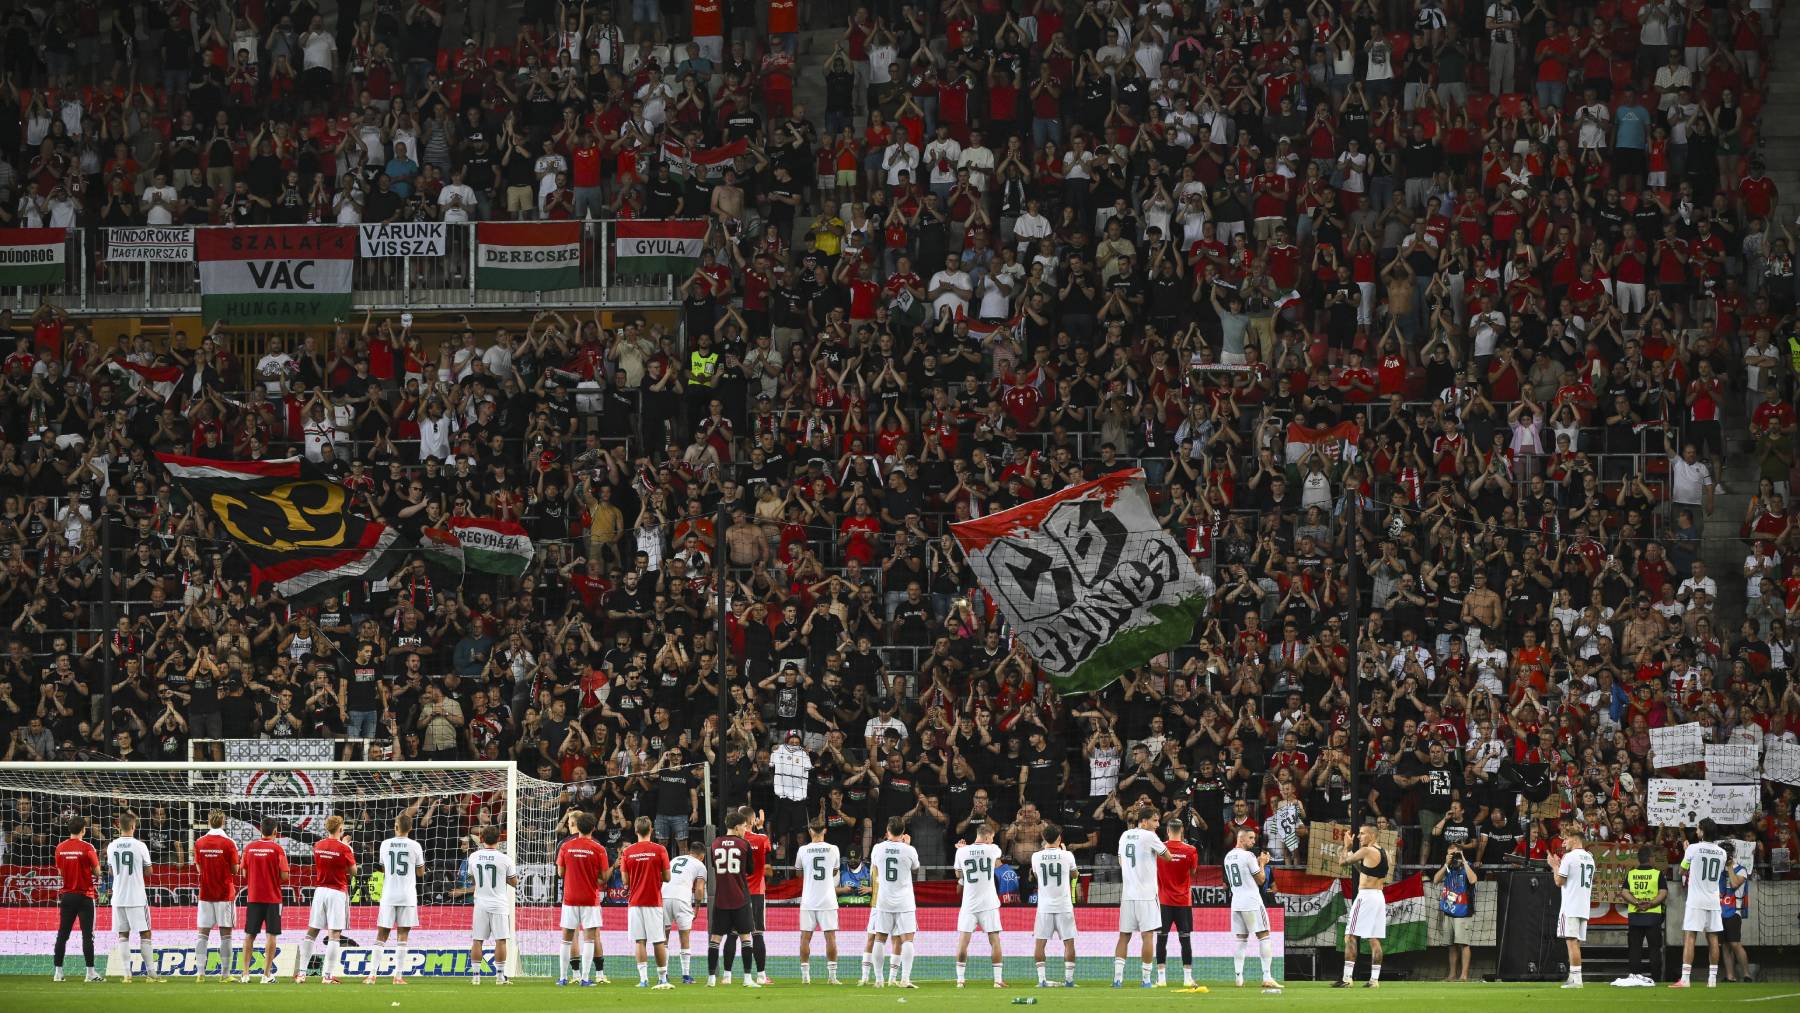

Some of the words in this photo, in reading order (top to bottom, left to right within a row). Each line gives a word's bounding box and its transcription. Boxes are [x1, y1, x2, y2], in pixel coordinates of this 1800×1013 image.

[368, 240, 438, 256] VISSZA
[486, 248, 579, 263] DERECSKE
[636, 240, 686, 254] GYULA
[246, 260, 315, 290] VÁC
[226, 301, 320, 317] HUNGARY
[113, 850, 134, 876] 19
[388, 850, 409, 876] 15
[672, 858, 689, 874] 2
[714, 848, 741, 874] 26
[1125, 843, 1137, 868] 9
[476, 863, 497, 889] 17
[813, 856, 826, 881] 5
[885, 857, 898, 882] 6
[964, 857, 992, 884] 24
[1040, 862, 1062, 887] 14
[1225, 863, 1243, 888] 18
[1580, 863, 1595, 889] 13
[1701, 856, 1721, 882] 10
[1634, 881, 1649, 890] 507
[1285, 896, 1321, 912] klós
